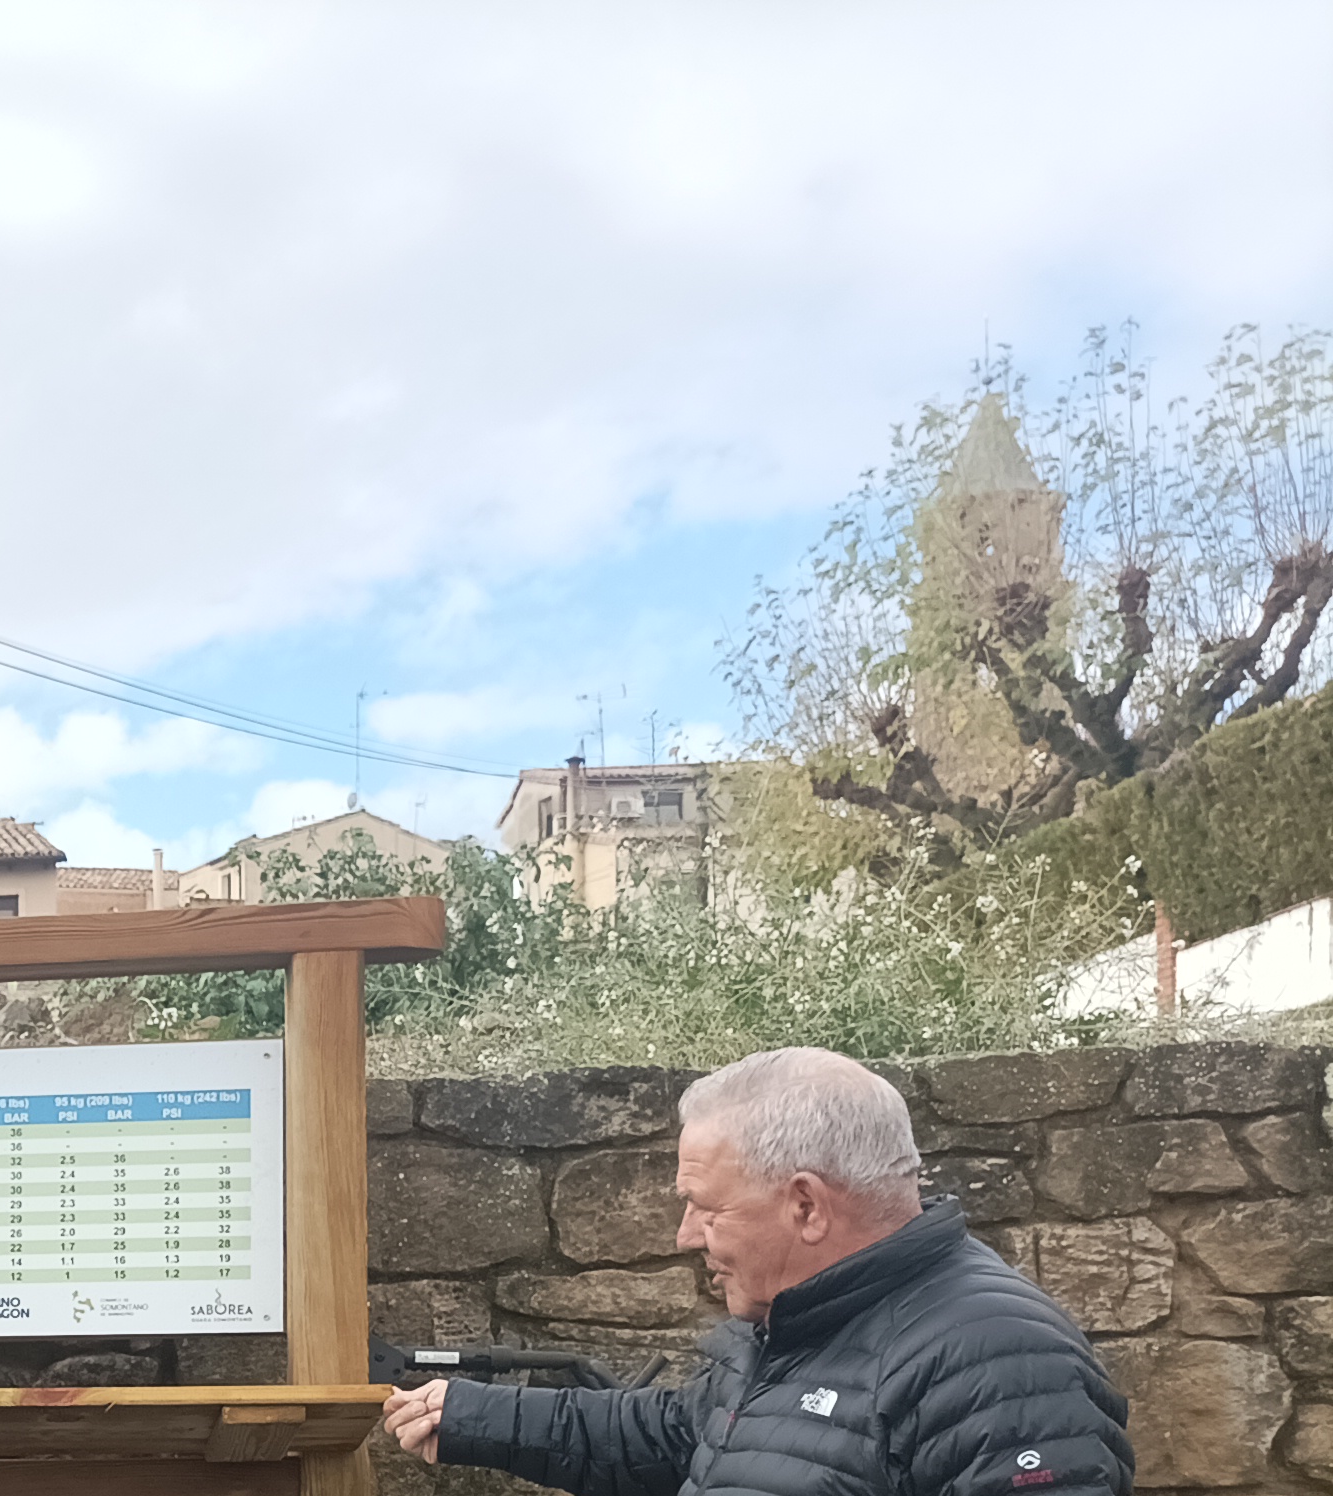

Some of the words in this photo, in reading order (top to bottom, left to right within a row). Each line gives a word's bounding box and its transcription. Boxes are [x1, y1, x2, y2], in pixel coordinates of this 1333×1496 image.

[7, 1097, 29, 1109] lbs)
[54, 1097, 68, 1106] 95
[70, 1097, 83, 1108] kg
[86, 1096, 110, 1106] (209
[112, 1096, 132, 1106] lbs)
[157, 1094, 175, 1103] 110
[178, 1094, 191, 1105] kg
[194, 1093, 216, 1104] (242
[220, 1092, 240, 1103] lbs)
[4, 1113, 29, 1123] BAR
[58, 1111, 77, 1121] PSI
[107, 1110, 132, 1120] BAR
[162, 1108, 181, 1118] PSI
[11, 1128, 22, 1137] 36
[11, 1157, 22, 1166] 32
[60, 1156, 75, 1164] 2.5
[114, 1154, 126, 1163] 36
[11, 1186, 22, 1195] 30
[61, 1185, 75, 1193] 2.4
[114, 1183, 126, 1192] 35
[165, 1182, 180, 1191] 2.6
[219, 1181, 231, 1189] 38
[10, 1215, 22, 1223] 29
[60, 1213, 75, 1222] 2.3
[114, 1212, 125, 1221] 33
[164, 1211, 179, 1220] 2.4
[219, 1210, 231, 1219] 35
[10, 1243, 22, 1252] 22
[61, 1242, 75, 1251] 1.7
[114, 1241, 126, 1250] 25
[165, 1240, 180, 1249] 1.9
[218, 1239, 230, 1248] 28
[11, 1272, 22, 1281] 12
[115, 1270, 126, 1279] 15
[165, 1269, 179, 1278] 1.2
[220, 1268, 230, 1277] 17
[190, 1304, 253, 1316] SABOREA
